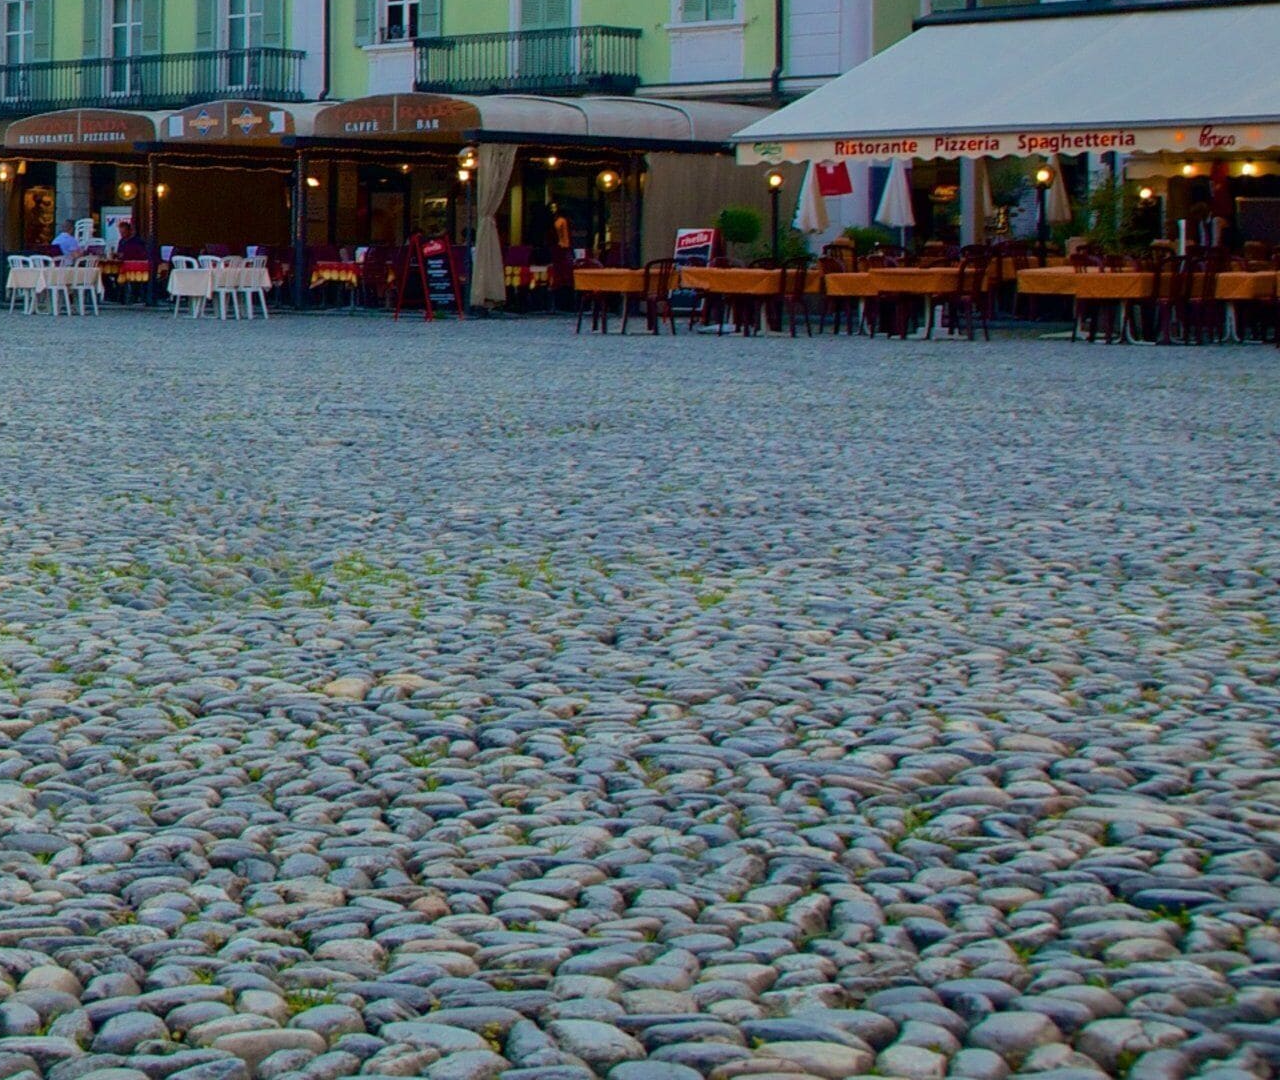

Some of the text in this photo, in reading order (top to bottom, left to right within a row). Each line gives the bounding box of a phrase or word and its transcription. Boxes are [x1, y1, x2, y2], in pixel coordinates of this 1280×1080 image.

[415, 118, 440, 130] BAR
[18, 132, 126, 144] RISTORANTE PIZZERIA
[834, 138, 918, 155] Ristorante
[934, 135, 1000, 151] Pizzeria
[1017, 131, 1136, 153] Spaghetteria
